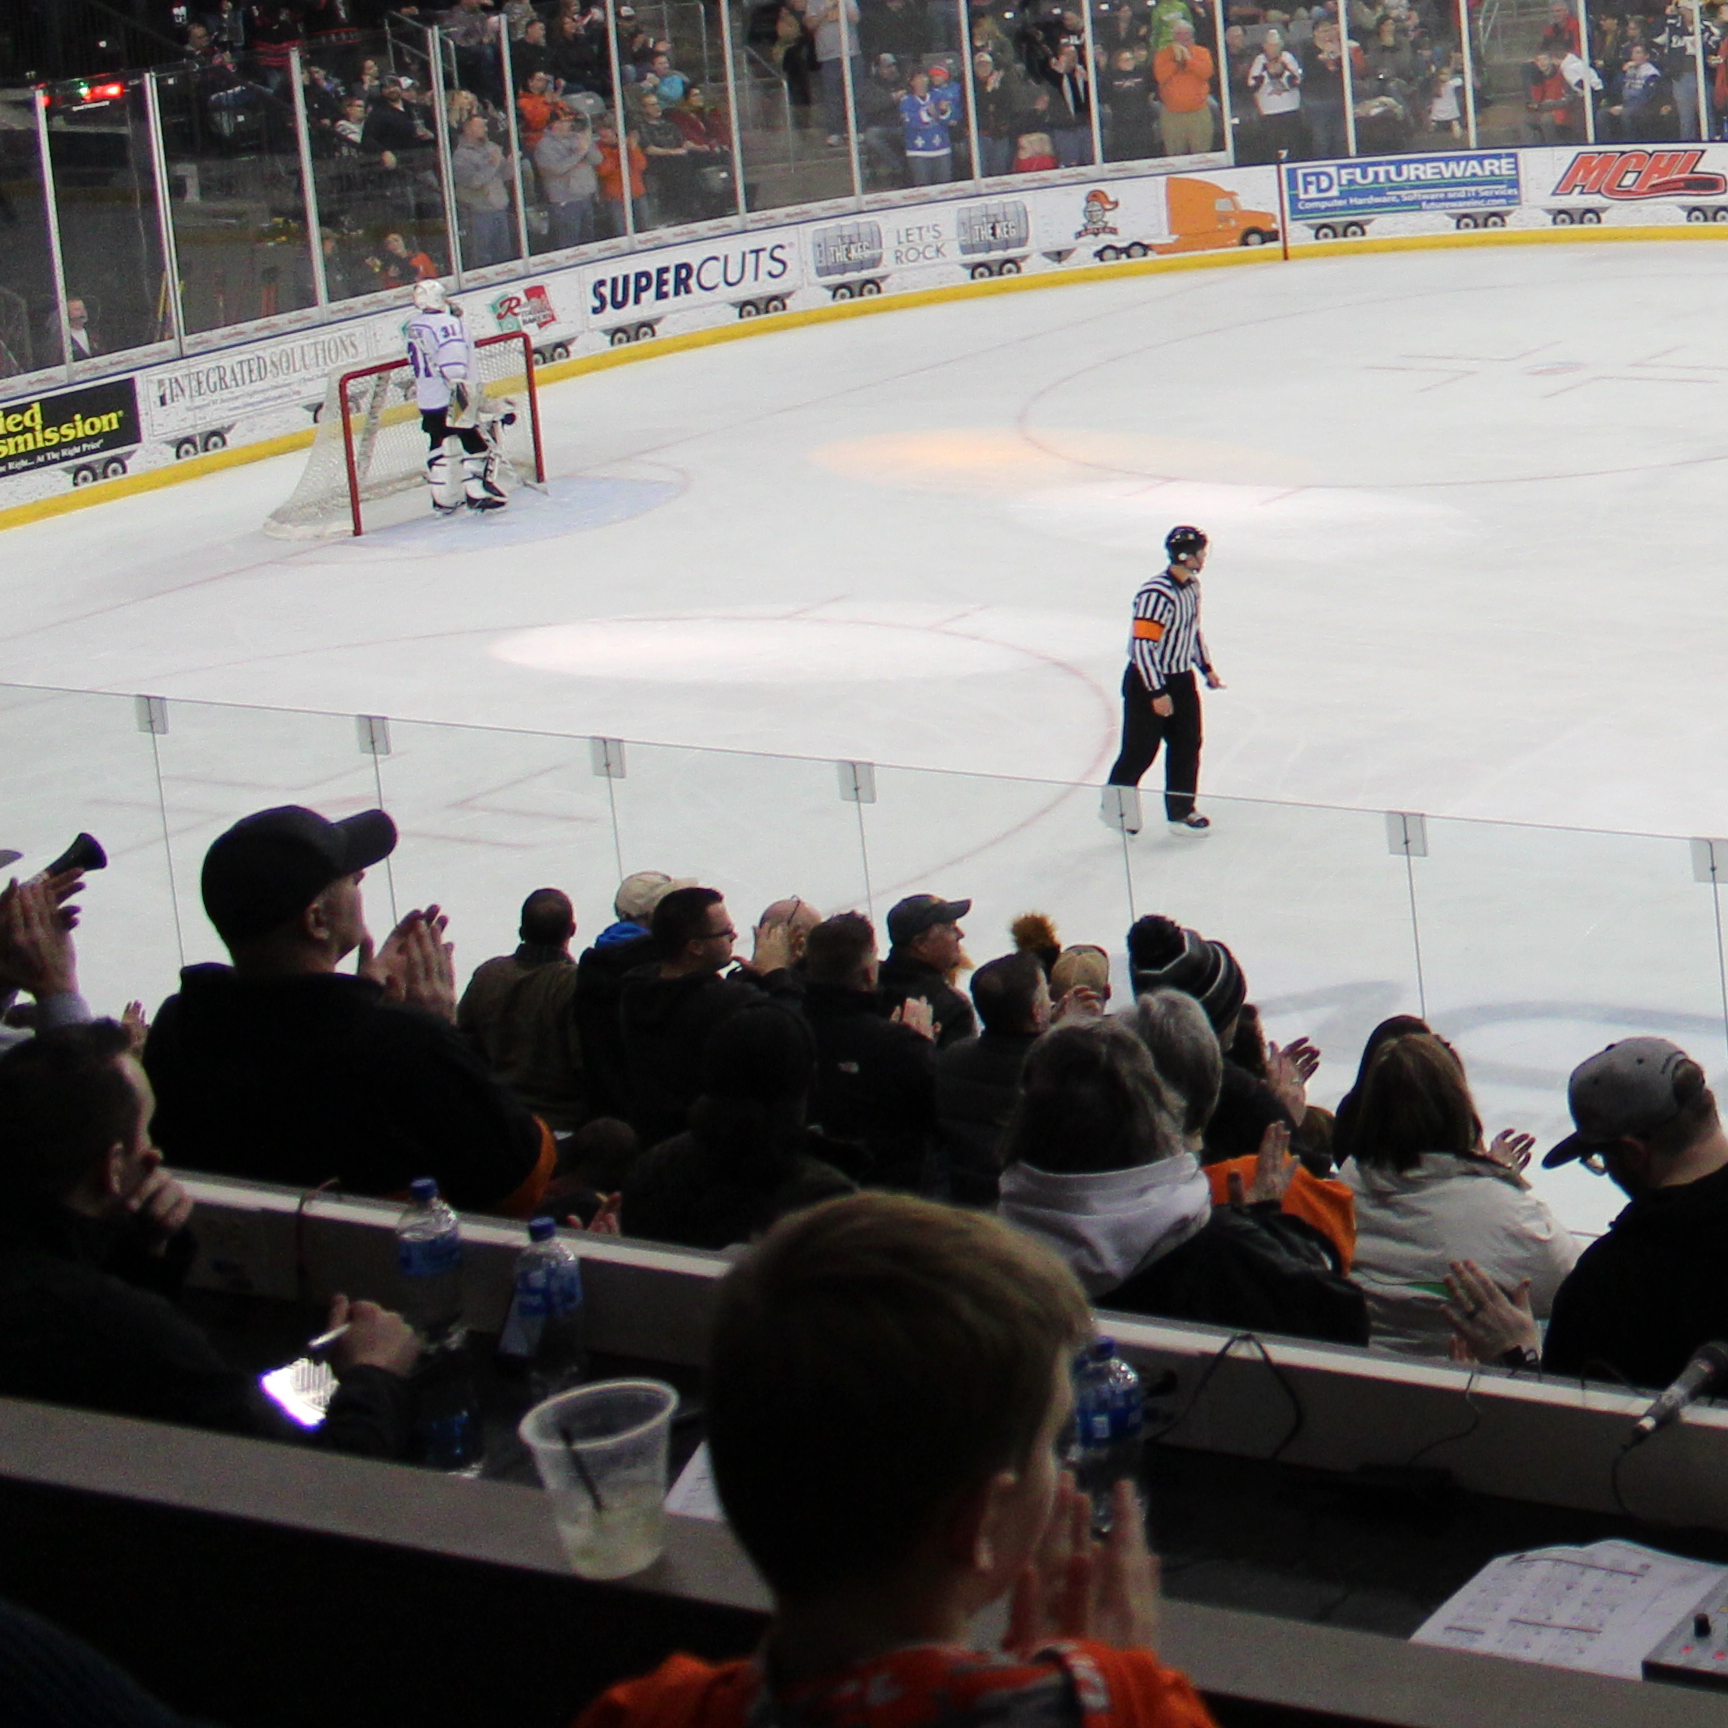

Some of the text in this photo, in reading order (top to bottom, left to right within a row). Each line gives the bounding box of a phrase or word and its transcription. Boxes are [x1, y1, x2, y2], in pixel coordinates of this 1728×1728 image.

[1340, 158, 1518, 186] FUTUREWARE
[1298, 198, 1348, 210] Computer
[1349, 195, 1400, 206] Hardware,
[1401, 190, 1445, 203] Software
[1447, 189, 1466, 199] and
[1477, 187, 1518, 198] Services
[896, 224, 942, 245] LET'S
[997, 220, 1016, 238] KEG
[894, 243, 947, 264] ROCK
[590, 241, 790, 315] SUPERCUTS
[440, 323, 458, 339] 31
[167, 358, 268, 405] INTEGRATED
[268, 334, 359, 380] SOLUTIONS
[61, 446, 81, 460] Right
